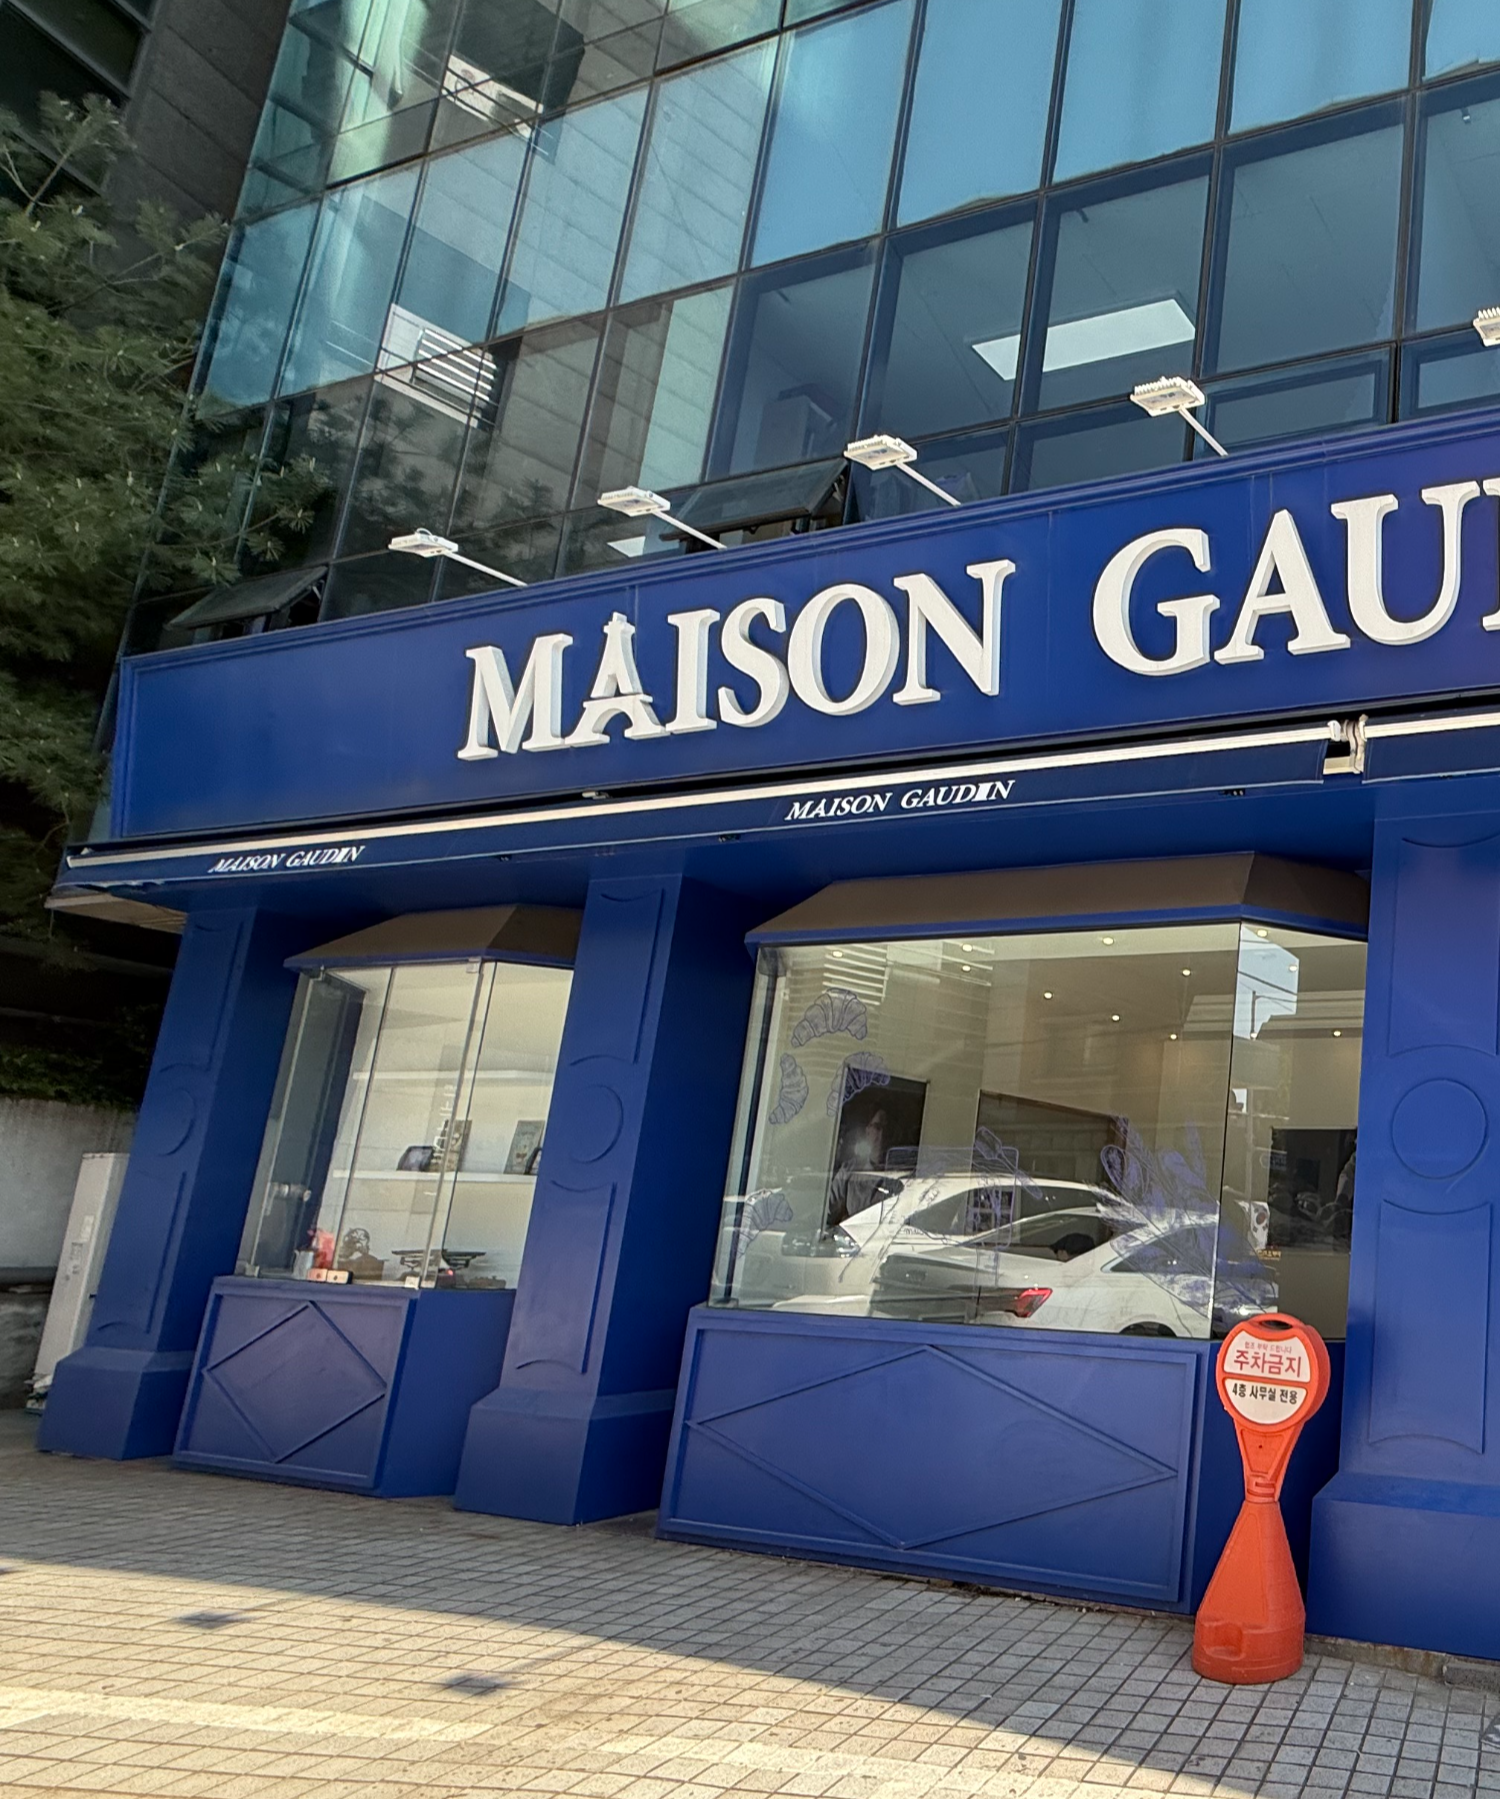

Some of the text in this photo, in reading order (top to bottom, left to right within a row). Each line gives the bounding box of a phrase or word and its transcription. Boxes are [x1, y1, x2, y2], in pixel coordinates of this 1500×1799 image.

[457, 558, 1016, 761] MAISON
[784, 780, 1016, 821] MAISON GAUDIN
[207, 845, 366, 874] MAISON GAUDIN
[1233, 1349, 1302, 1378] 주차금지
[1232, 1382, 1298, 1405] 4층 사무실 전용
